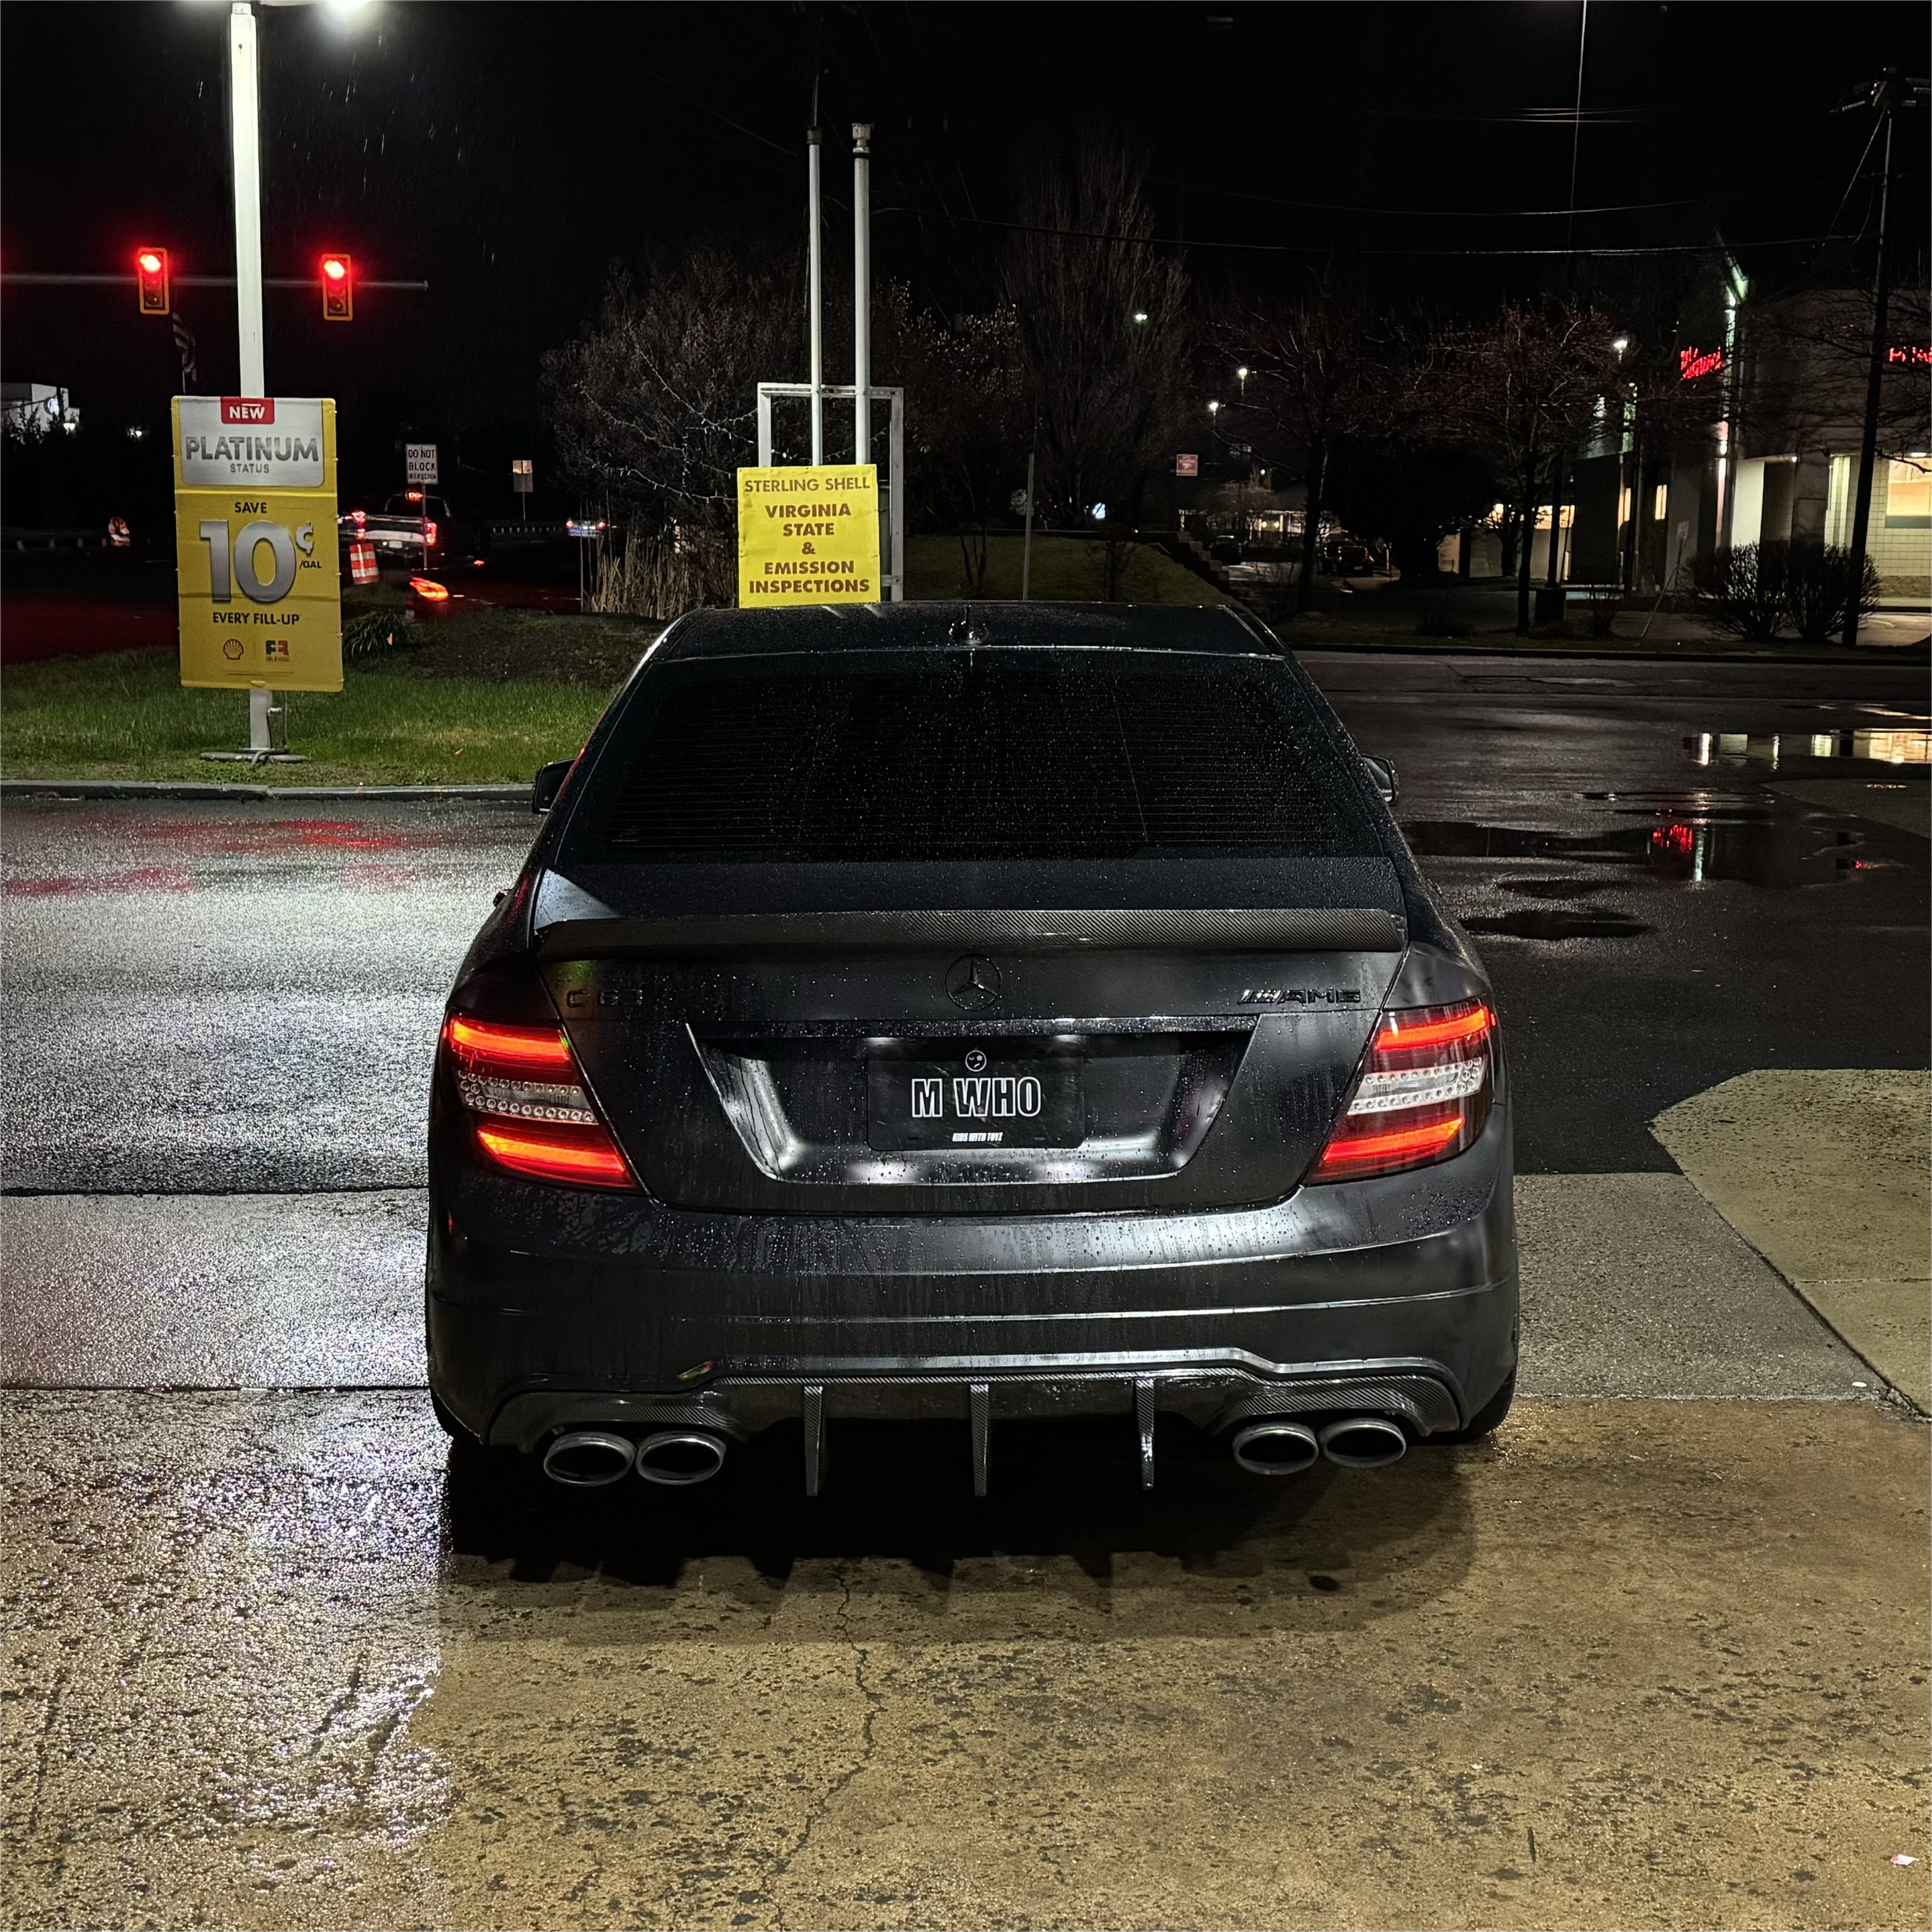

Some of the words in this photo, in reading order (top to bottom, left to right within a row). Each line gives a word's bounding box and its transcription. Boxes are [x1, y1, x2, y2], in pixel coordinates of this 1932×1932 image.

[229, 406, 265, 419] NEW
[185, 436, 319, 462] PLATINUM
[408, 449, 419, 458] DO
[420, 449, 435, 459] NOT
[230, 463, 270, 474] STATUS
[408, 462, 436, 471] BLOCK
[744, 478, 820, 492] STERLING
[825, 477, 871, 491] SHELL
[235, 501, 268, 514] SAVE
[765, 503, 851, 518] VIRGINIA
[783, 523, 835, 537] STATE
[801, 541, 817, 555] &
[764, 560, 854, 575] EMISSION
[749, 579, 870, 593] INSPECTIONS
[212, 612, 250, 624] EVERY
[253, 613, 300, 625] FILL-UP
[912, 1078, 943, 1118] M
[952, 1076, 1041, 1117] WHO
